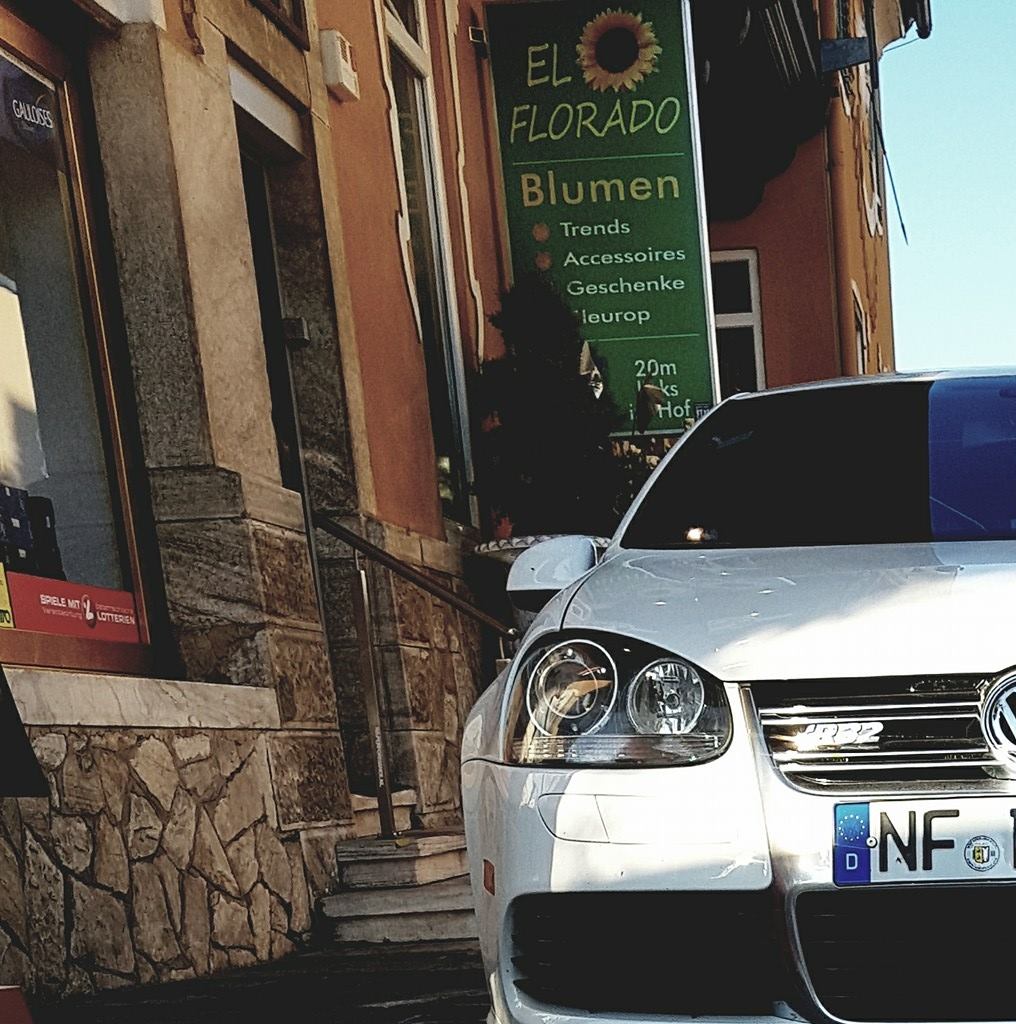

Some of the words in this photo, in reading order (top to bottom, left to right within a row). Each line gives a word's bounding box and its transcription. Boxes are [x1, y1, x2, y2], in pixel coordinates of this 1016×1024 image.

[527, 43, 572, 87] EL
[510, 96, 681, 144] FLORADO
[520, 170, 680, 207] Blumen
[560, 219, 631, 238] Trends
[563, 247, 686, 267] Accessoires
[566, 275, 685, 296] Geschenke
[573, 309, 651, 325] leurop
[634, 359, 677, 377] 20m
[637, 379, 679, 397] lks
[657, 398, 692, 419] Hof
[67, 599, 81, 609] MIT
[96, 611, 136, 625] LOTTERIEN
[879, 808, 960, 873] NF
[845, 852, 859, 870] D
